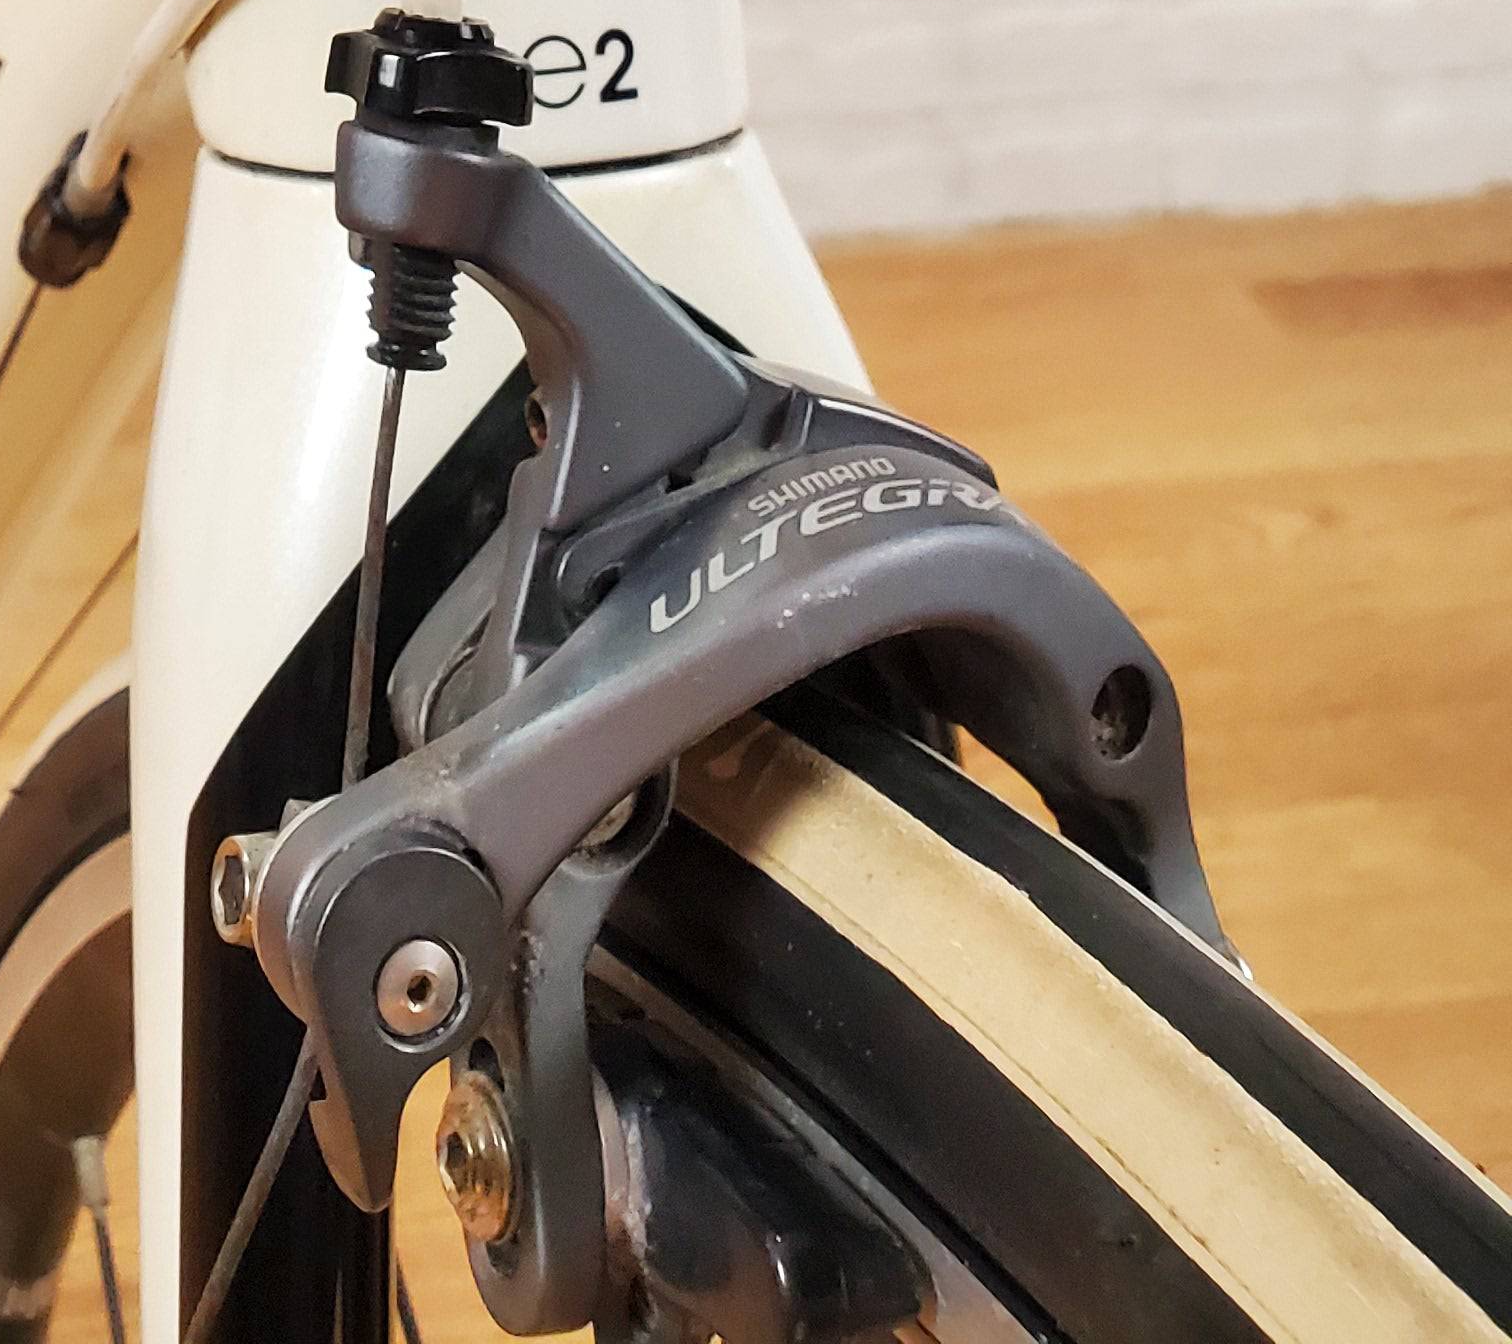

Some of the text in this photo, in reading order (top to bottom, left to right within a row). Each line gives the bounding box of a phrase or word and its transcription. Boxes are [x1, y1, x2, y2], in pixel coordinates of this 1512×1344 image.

[523, 28, 639, 109] e2
[747, 457, 897, 518] SHIMANO
[649, 478, 1024, 634] ULTEGR
